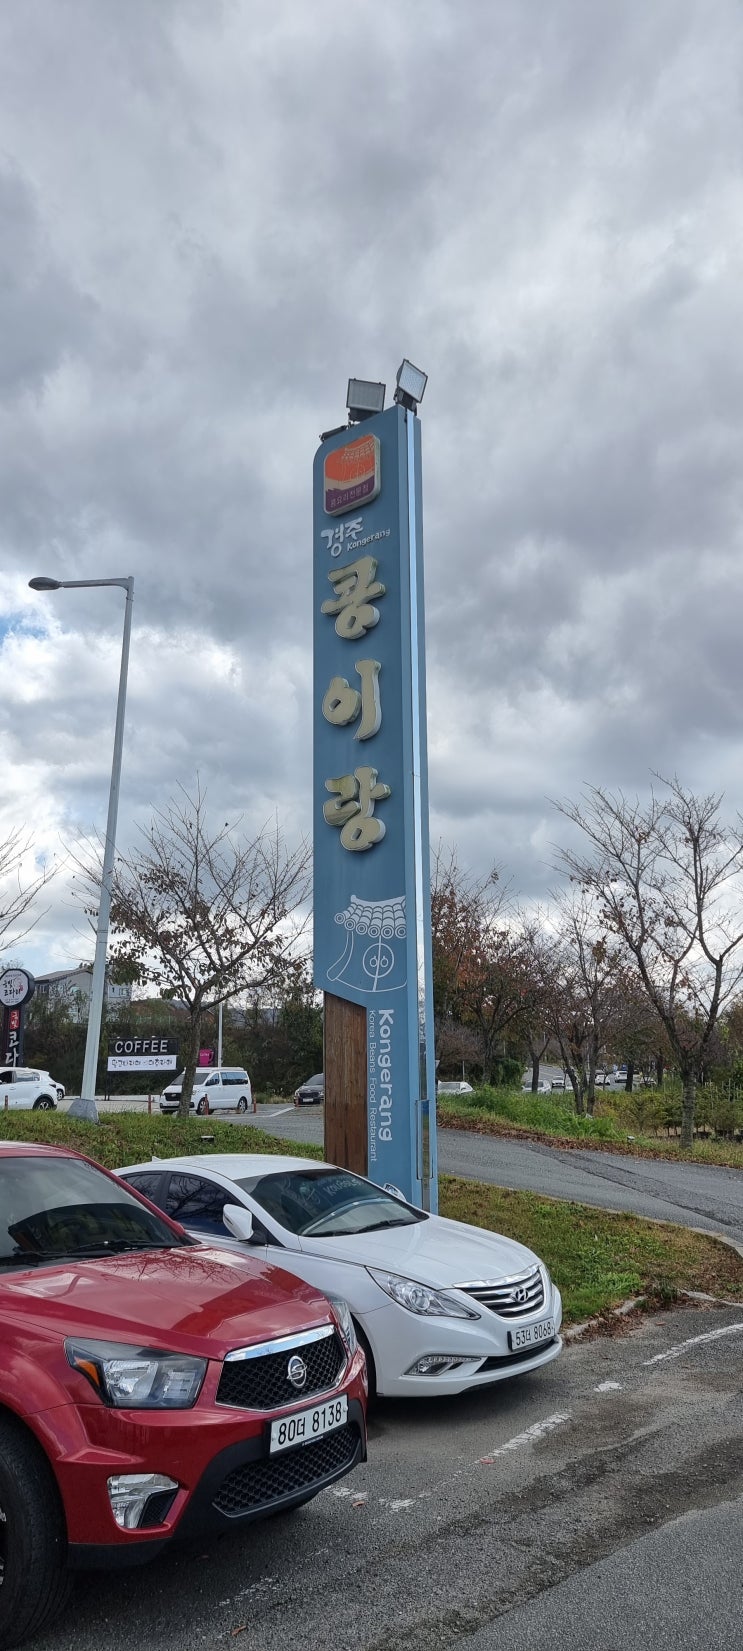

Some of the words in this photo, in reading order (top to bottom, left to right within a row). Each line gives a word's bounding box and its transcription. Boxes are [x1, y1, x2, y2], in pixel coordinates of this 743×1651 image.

[321, 517, 363, 557] 경주
[347, 528, 391, 552] Kongerang
[115, 1040, 168, 1053] COFFEE
[369, 1042, 377, 1073] Beans
[369, 1077, 377, 1103] Food
[378, 1009, 394, 1141] Kongerang
[369, 1107, 377, 1162] Restaurant
[515, 1329, 532, 1346] 53더
[533, 1321, 551, 1340] 8068
[278, 1417, 306, 1445] 80더
[312, 1401, 341, 1433] 8138
